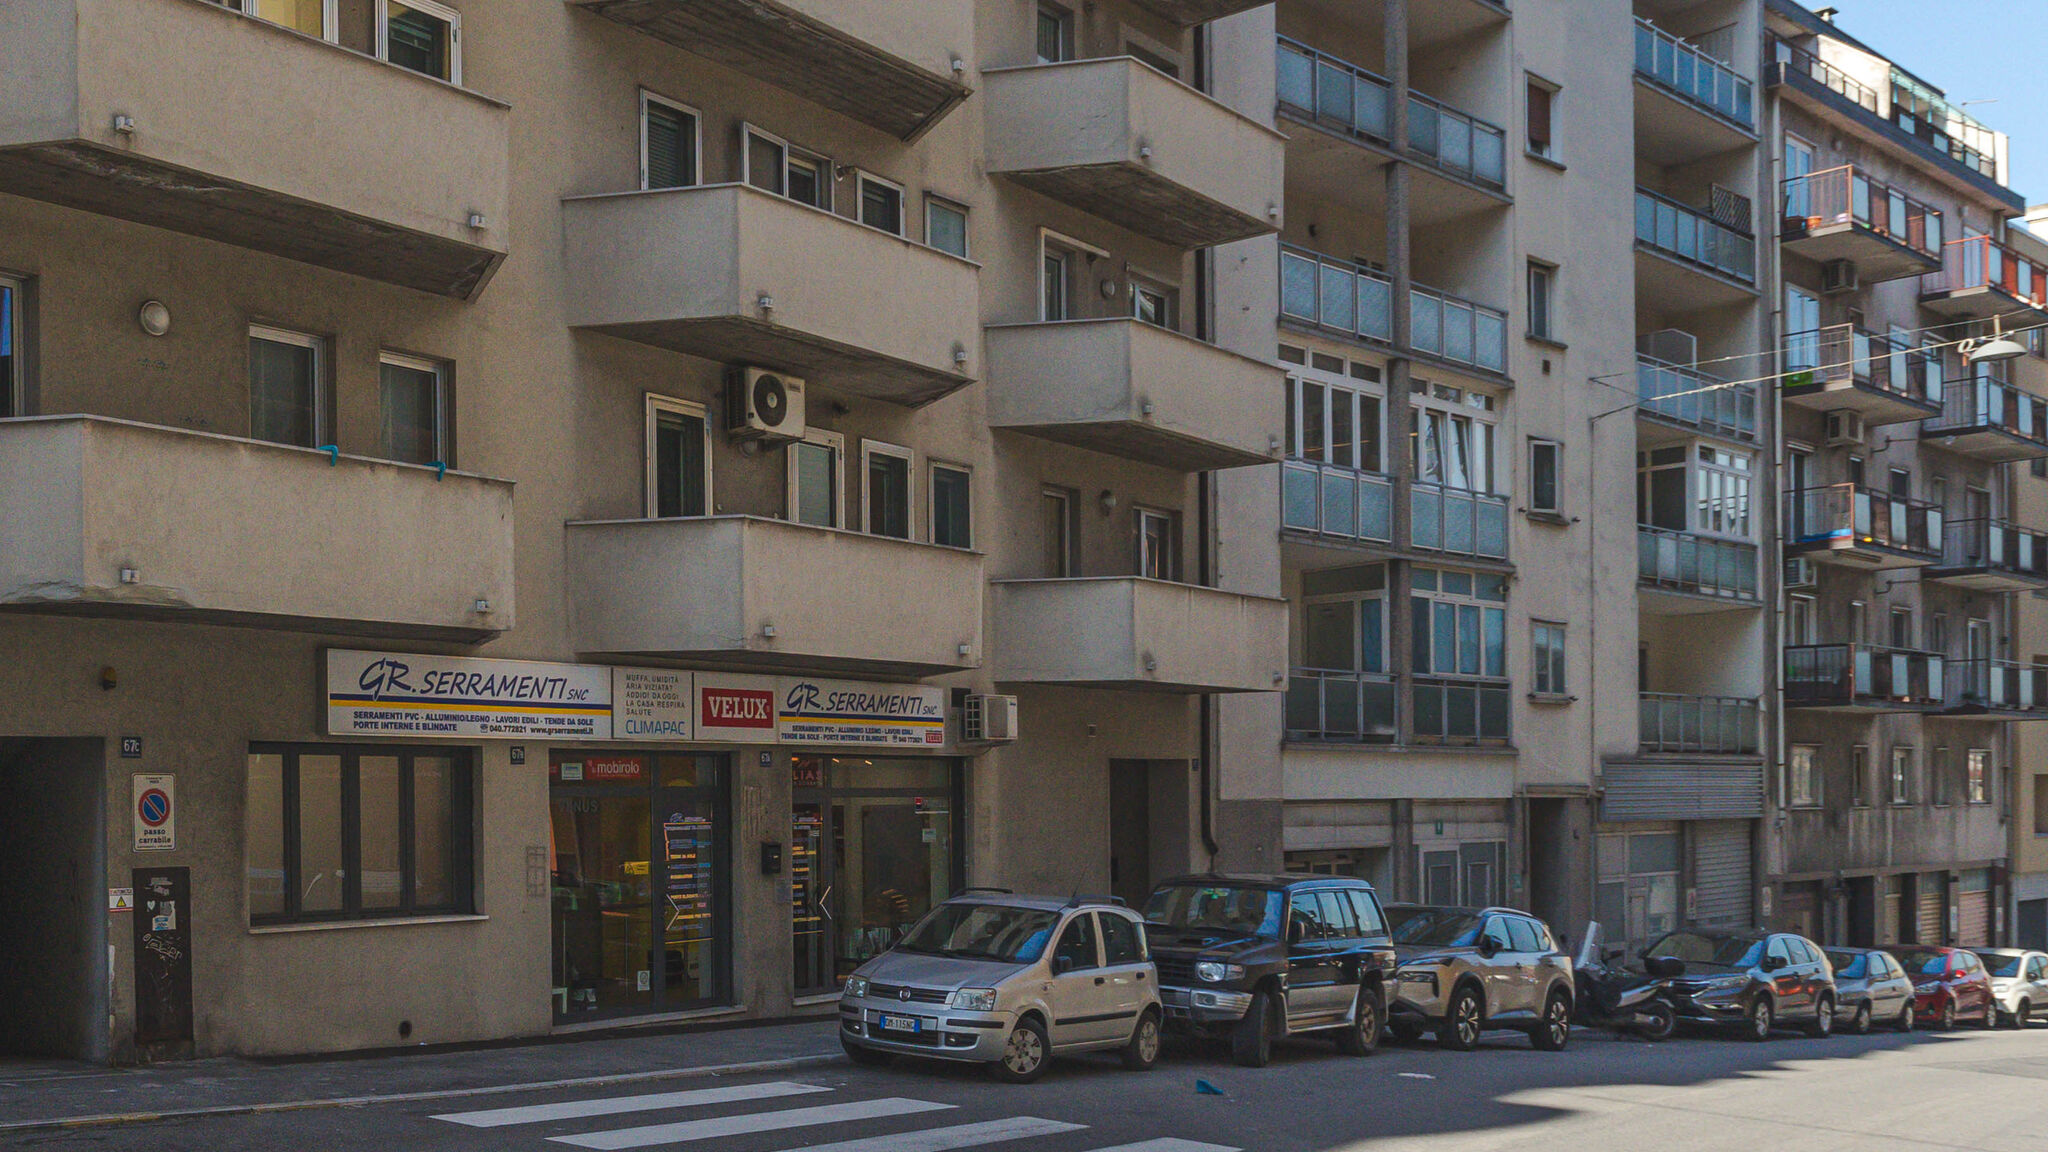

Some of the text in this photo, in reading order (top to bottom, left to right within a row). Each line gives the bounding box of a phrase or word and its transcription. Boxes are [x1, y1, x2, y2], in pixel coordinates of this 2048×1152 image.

[420, 670, 567, 699] SERRAMENTI
[567, 688, 590, 701] SNC
[626, 682, 641, 690] ARIA
[636, 700, 654, 708] CASA
[657, 701, 686, 709] RESPIRA
[708, 695, 767, 720] VELUX
[826, 692, 922, 715] SERRAMENTI
[626, 708, 652, 716] SALUTE
[353, 711, 403, 721] SERRAMENTI
[404, 711, 419, 721] PVC
[495, 715, 521, 725] LAVORI
[521, 716, 539, 725] EDILI
[544, 717, 566, 726] TENDE
[567, 718, 576, 726] DA
[577, 718, 594, 727] SOLE
[353, 720, 378, 730] PORTE
[380, 721, 413, 731] INTERNE
[415, 722, 421, 731] E
[421, 722, 457, 732] BLINDATE
[626, 719, 686, 736] CLIMAPAC
[597, 760, 640, 774] mobirolo
[143, 829, 167, 839] passo
[138, 837, 172, 845] carrabile
